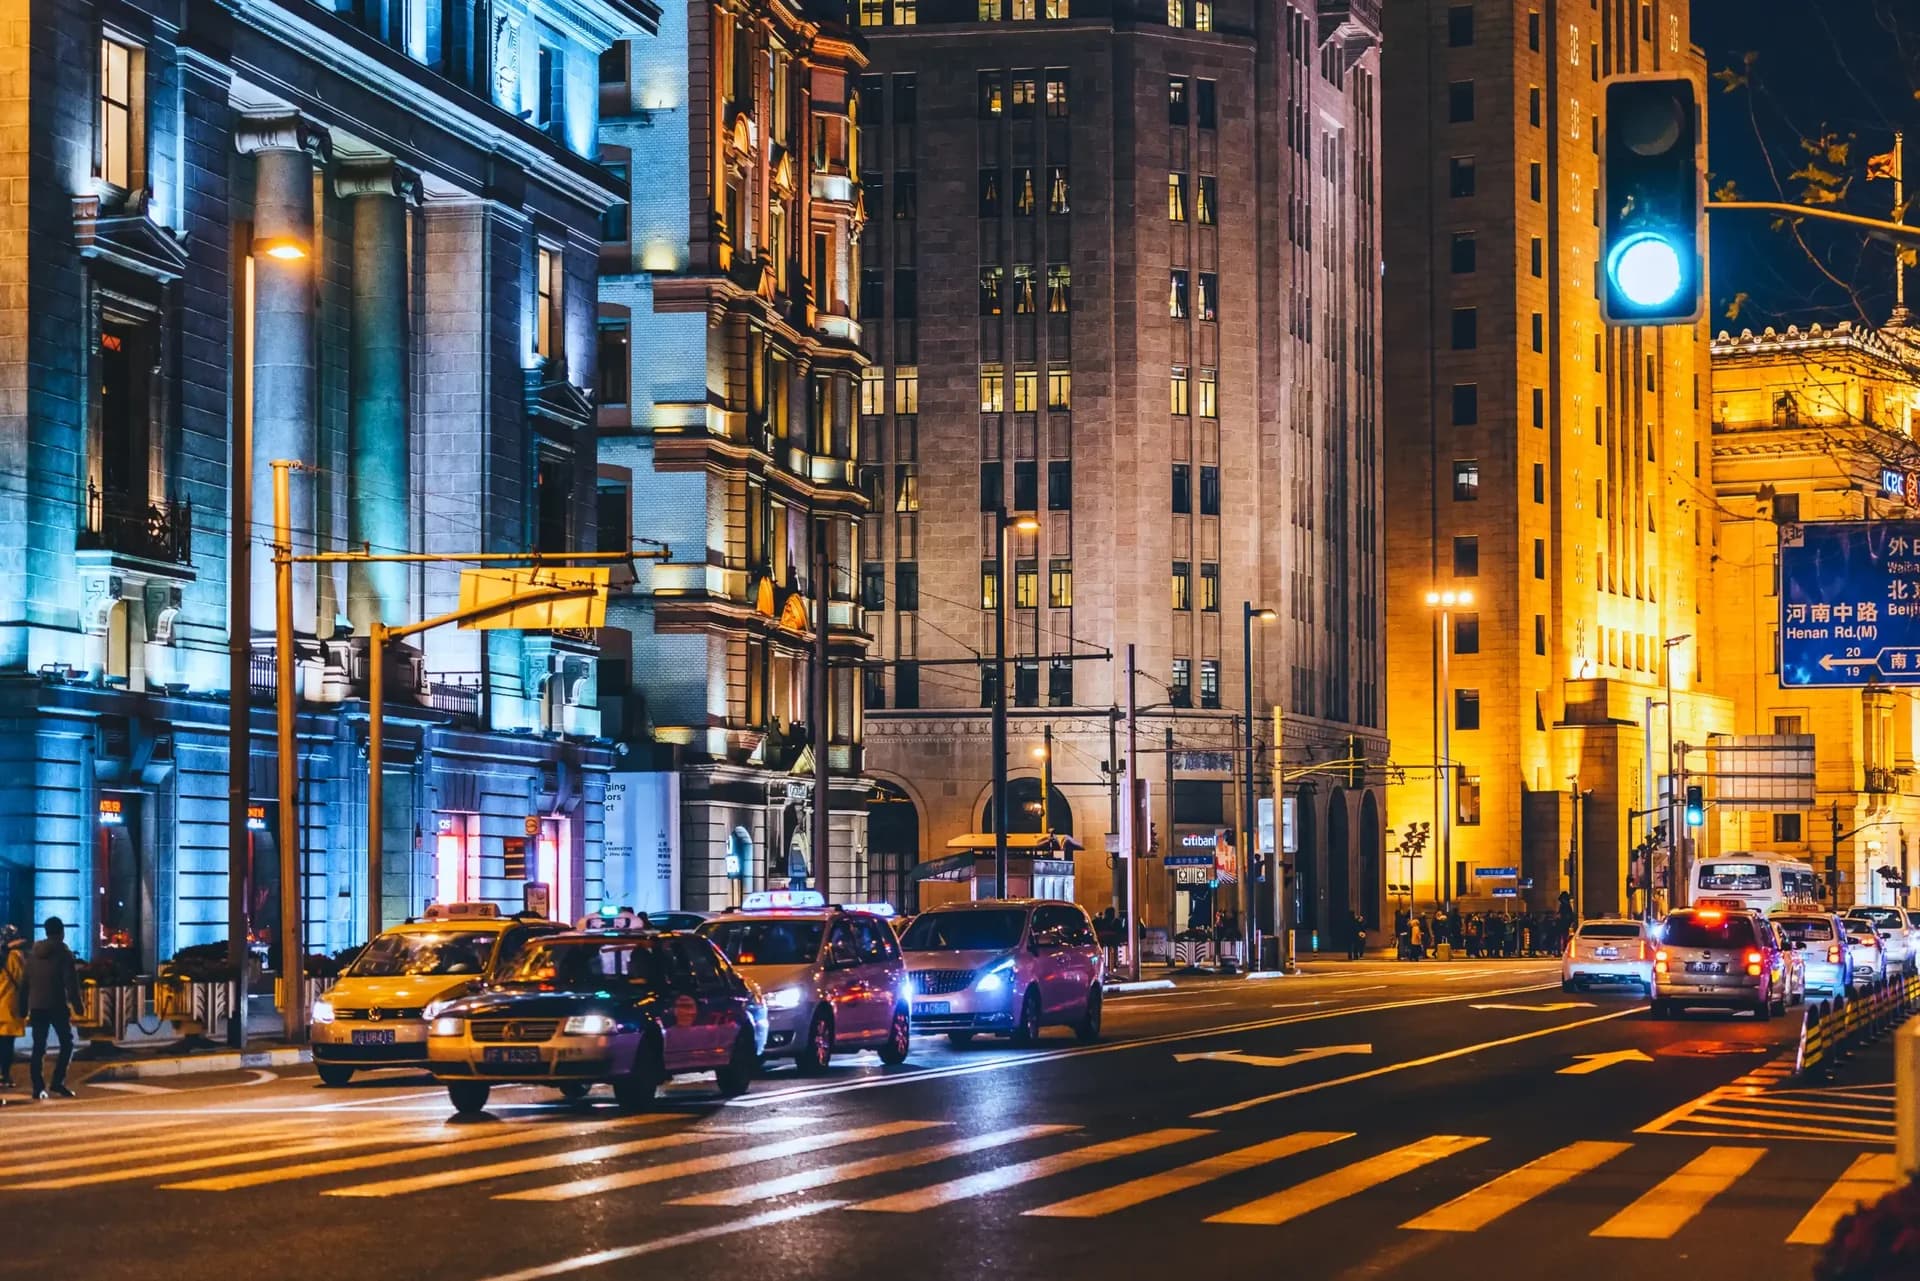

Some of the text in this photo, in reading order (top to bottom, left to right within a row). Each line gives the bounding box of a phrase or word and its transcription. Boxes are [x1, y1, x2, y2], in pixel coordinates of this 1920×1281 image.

[1883, 470, 1904, 496] ICBC
[1786, 601, 1878, 623] 河南中路
[1786, 625, 1877, 640] Henan Rd.(M)
[1846, 647, 1860, 657] 20
[1846, 667, 1859, 676] 19
